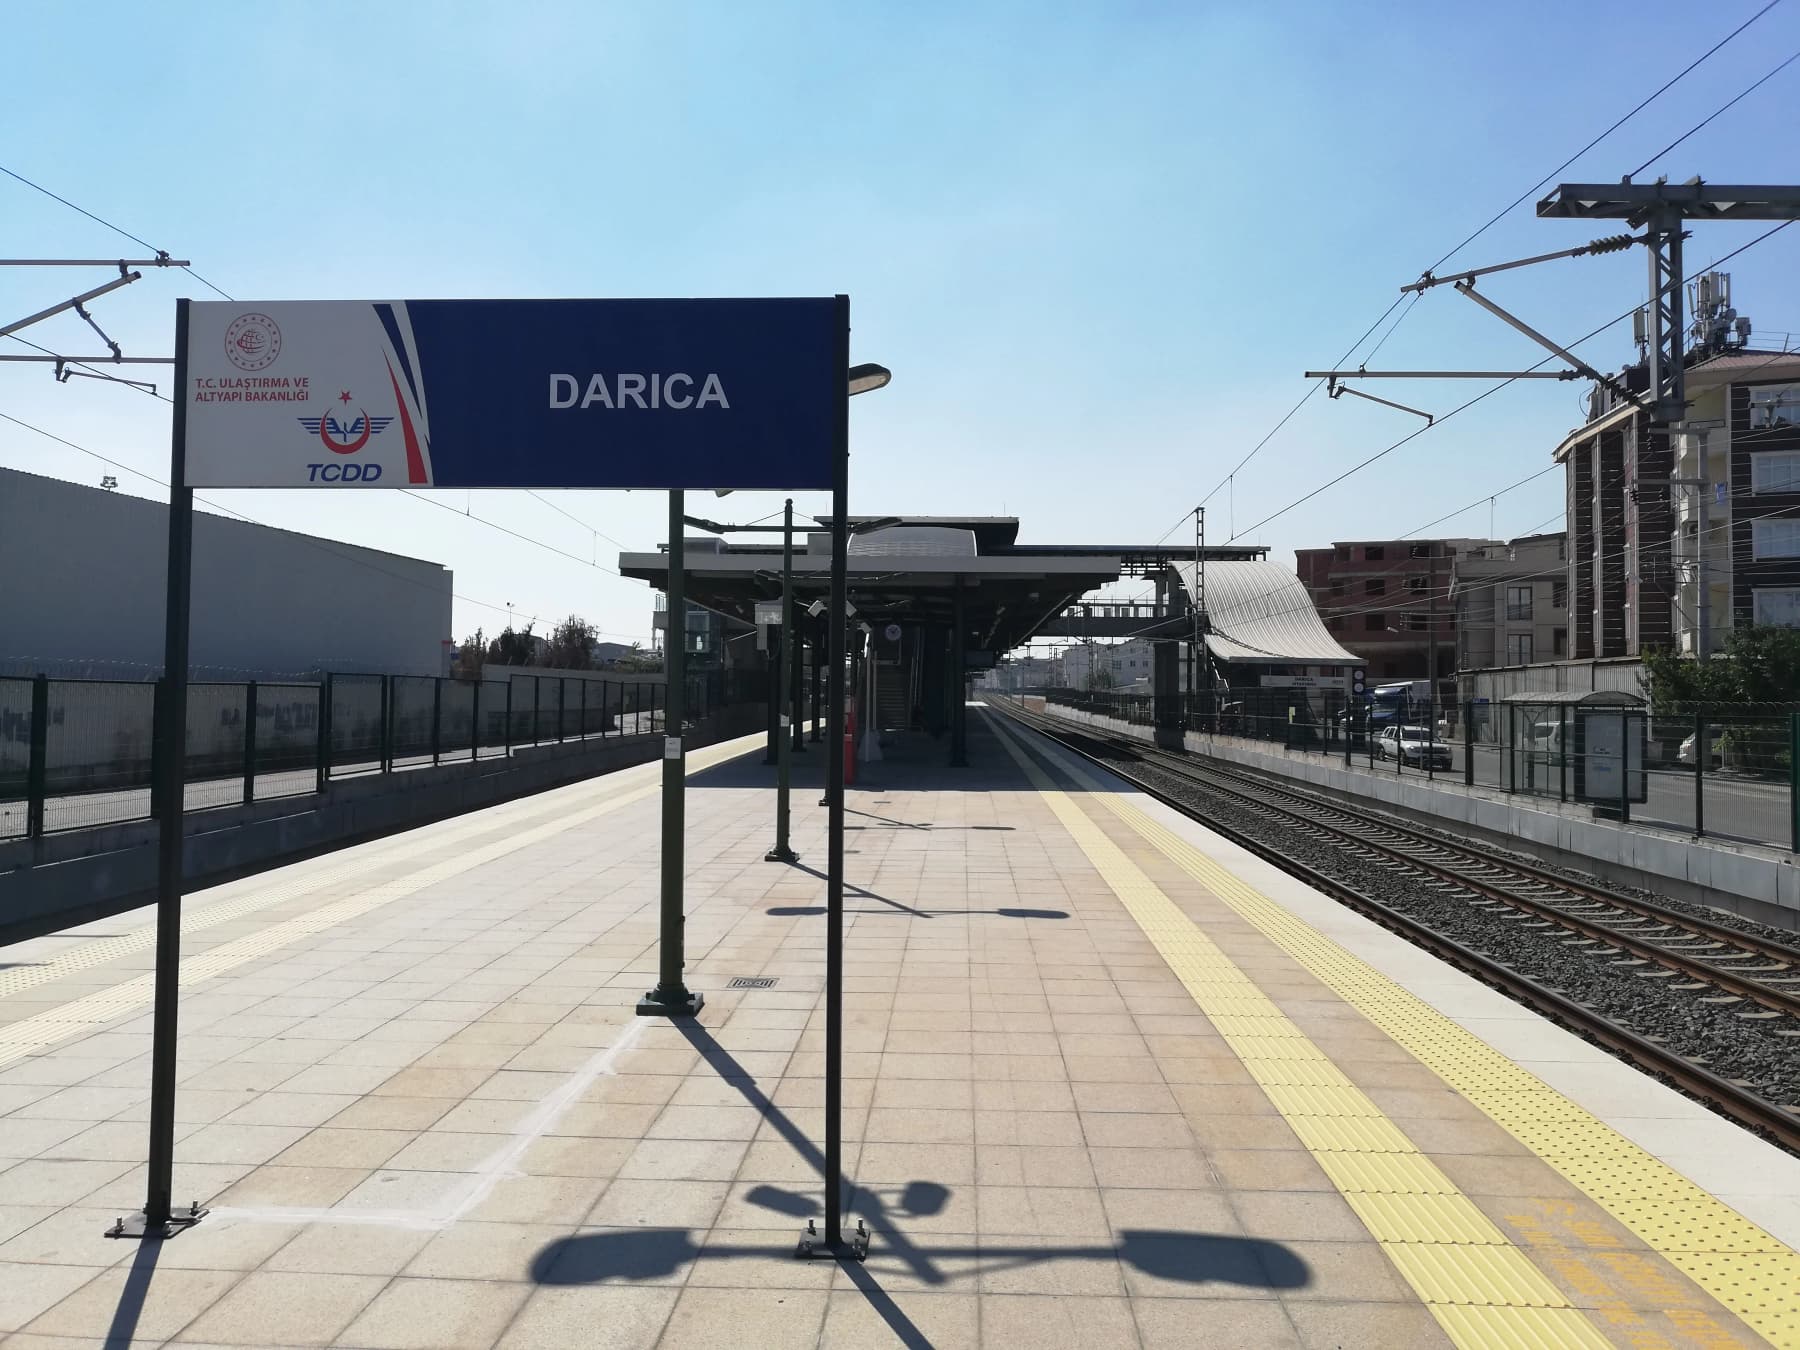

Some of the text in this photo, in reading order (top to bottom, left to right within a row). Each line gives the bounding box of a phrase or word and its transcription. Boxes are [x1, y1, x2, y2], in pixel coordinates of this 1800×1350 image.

[195, 377, 309, 391] T.C. ULAŞTIRMA VE
[549, 373, 730, 409] DARICA
[195, 389, 308, 402] ALTYAPI BAKANLIĞI
[306, 463, 382, 482] TCDD
